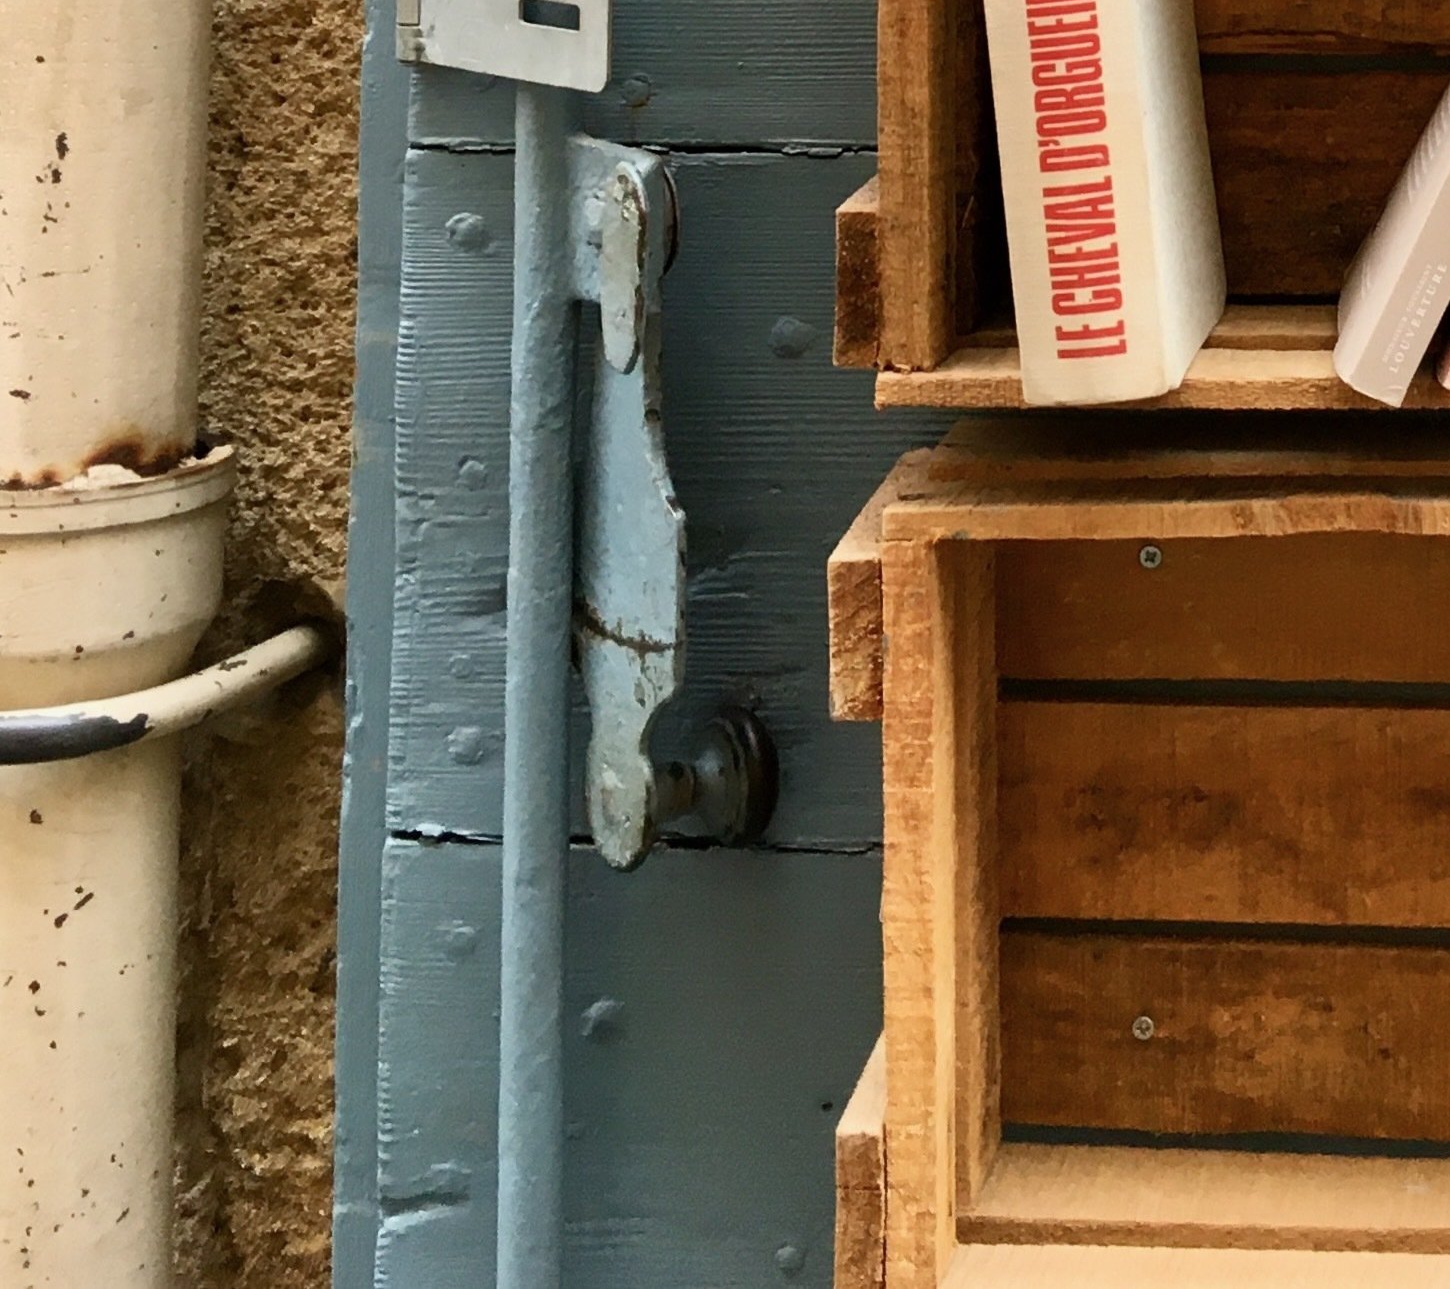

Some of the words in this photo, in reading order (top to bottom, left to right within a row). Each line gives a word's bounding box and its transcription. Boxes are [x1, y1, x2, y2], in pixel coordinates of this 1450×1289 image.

[1043, 175, 1122, 316] CHEVAL
[1055, 320, 1127, 359] LE
[1389, 263, 1448, 374] LOUVERTURE
